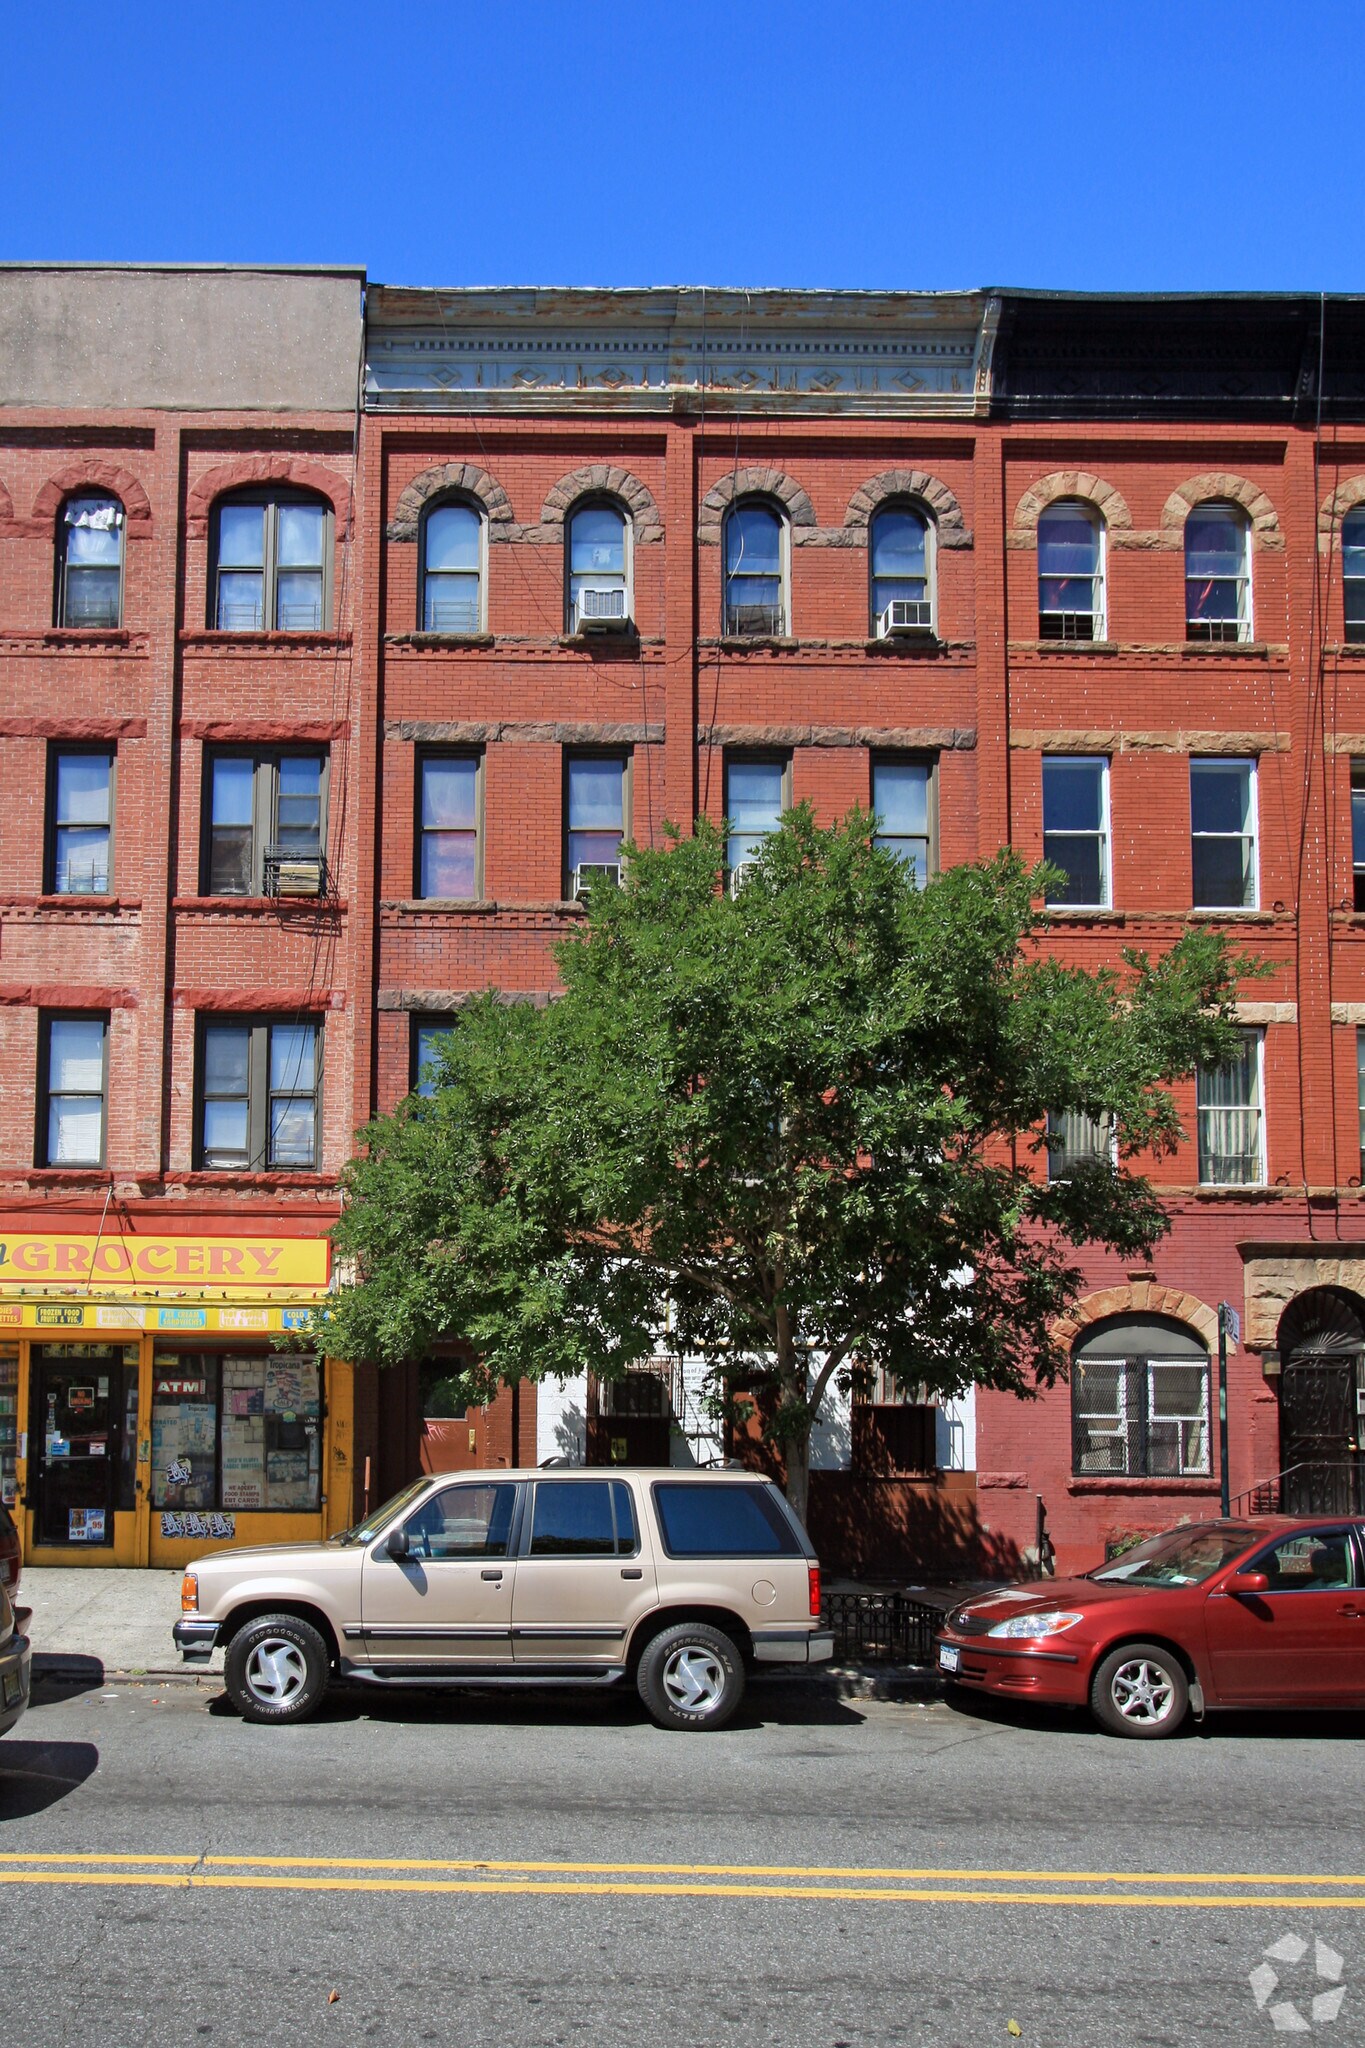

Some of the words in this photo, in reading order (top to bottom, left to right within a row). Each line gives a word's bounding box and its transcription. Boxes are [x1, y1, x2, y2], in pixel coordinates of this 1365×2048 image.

[11, 1242, 284, 1276] GROCERY
[40, 1307, 62, 1315] FROZEN
[64, 1307, 80, 1315] FOOD
[40, 1315, 58, 1323] FRUITS
[269, 1361, 300, 1369] Tropicana
[157, 1381, 199, 1392] ATM
[92, 1521, 103, 1529] 99
